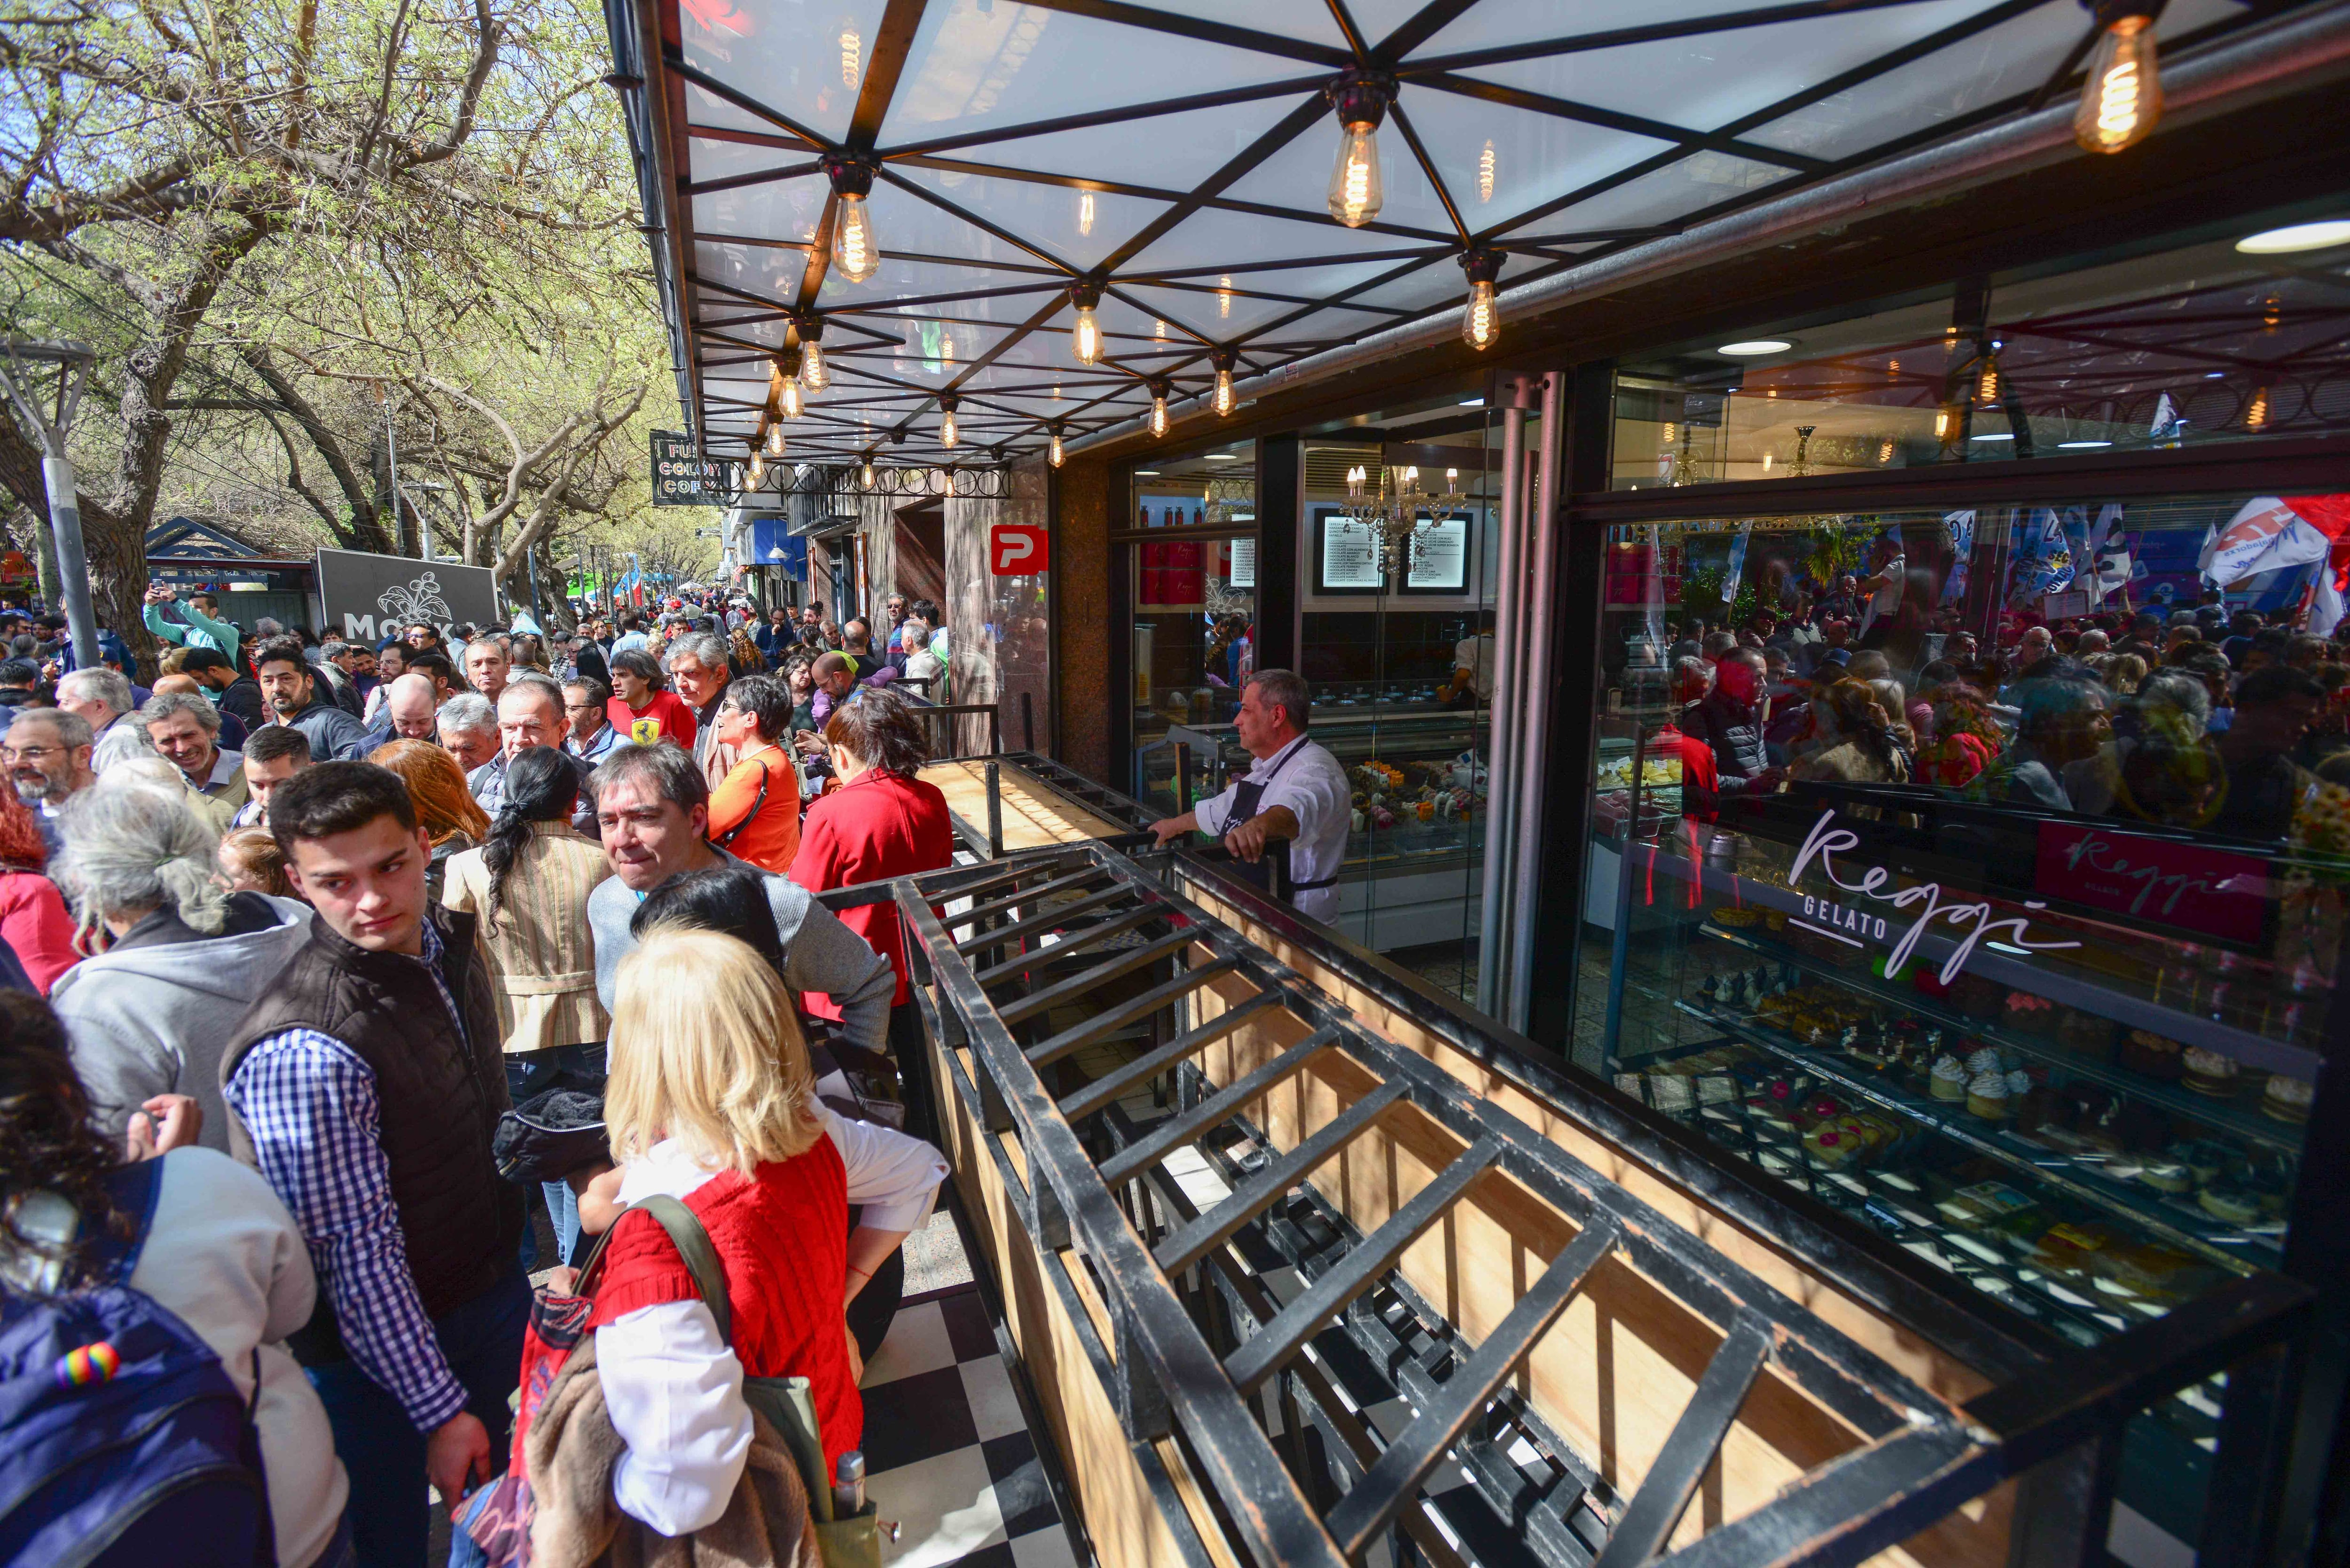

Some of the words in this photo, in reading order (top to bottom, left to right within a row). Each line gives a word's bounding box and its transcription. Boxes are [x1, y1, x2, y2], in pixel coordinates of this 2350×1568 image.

[659, 461, 721, 476] COLOR
[663, 480, 717, 494] COPY
[999, 533, 1034, 568] P
[1788, 809, 2082, 985] Reggi
[1804, 895, 1886, 940] GELATO
